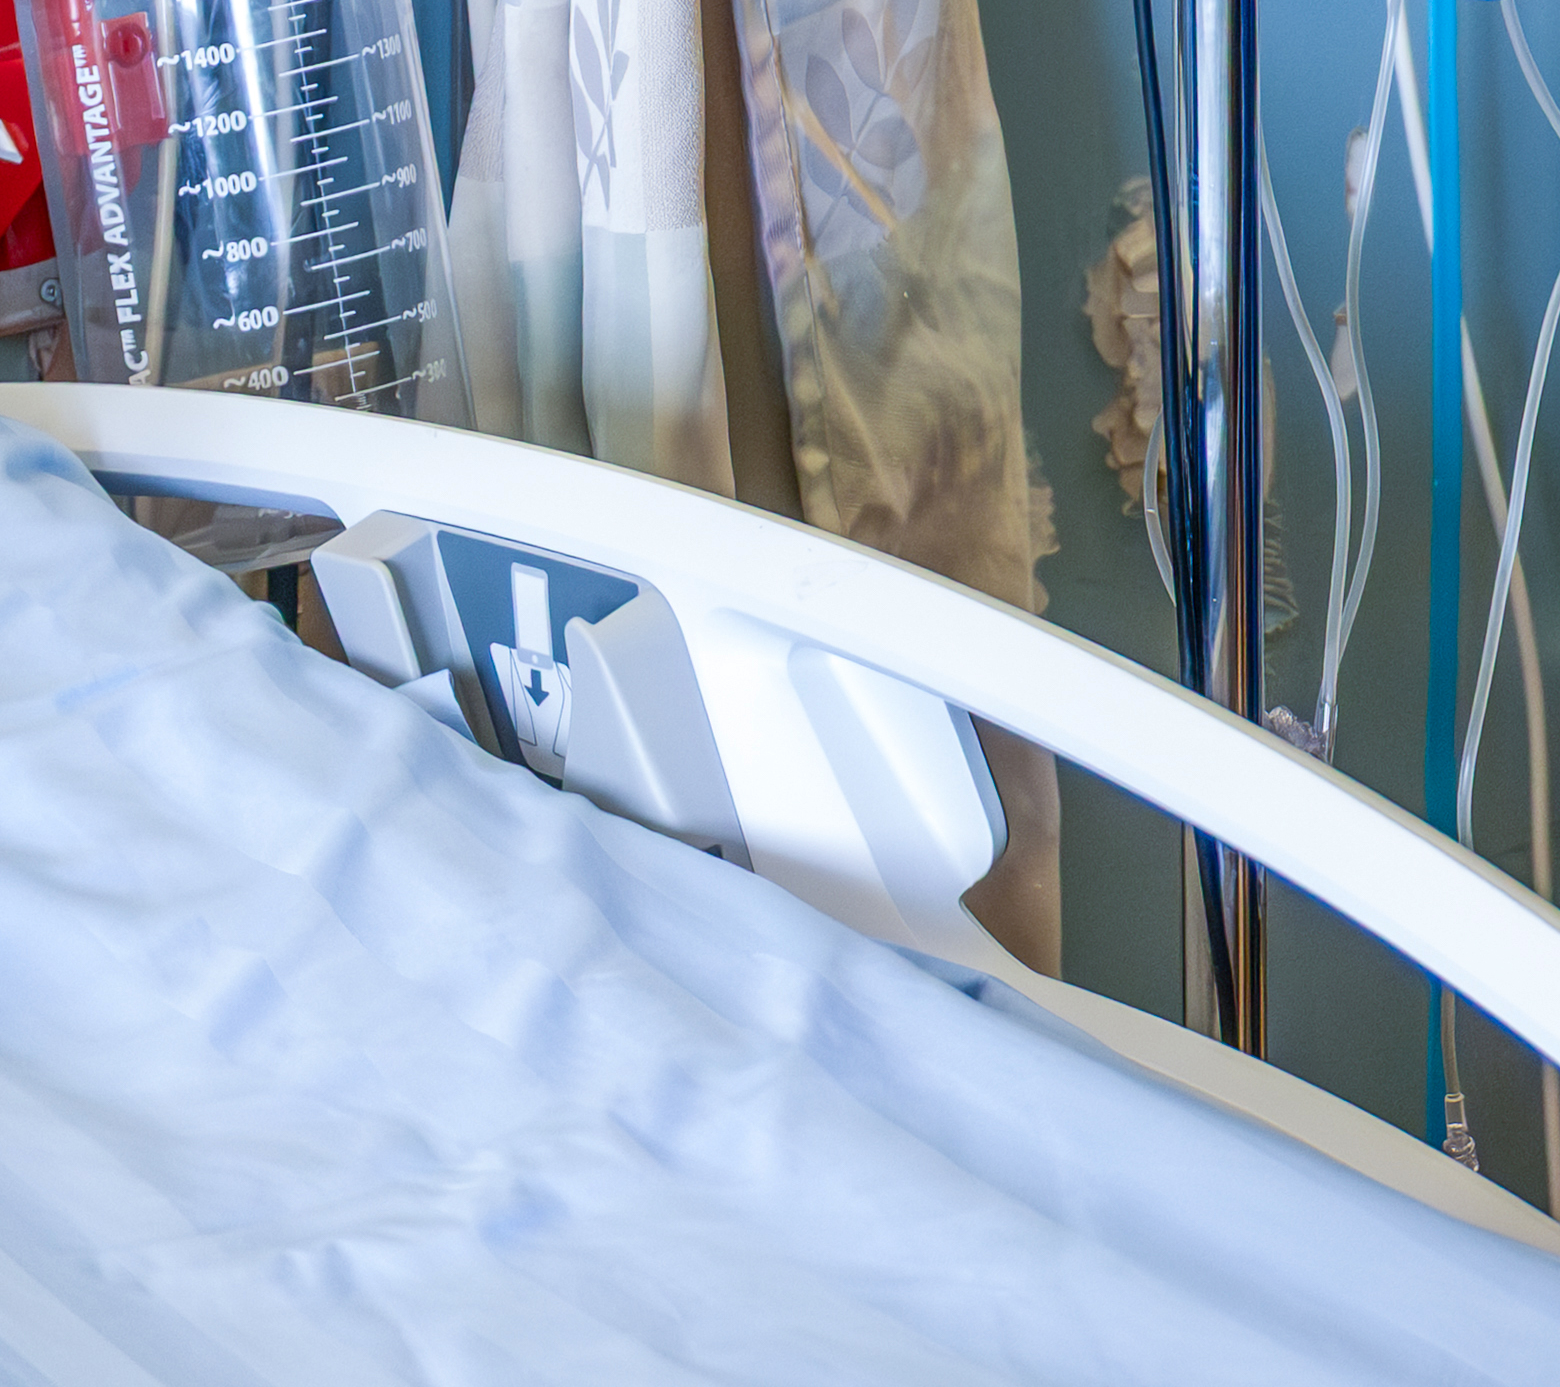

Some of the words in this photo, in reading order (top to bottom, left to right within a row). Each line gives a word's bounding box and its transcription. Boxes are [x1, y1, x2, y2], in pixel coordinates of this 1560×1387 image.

[156, 41, 236, 71] ~1400
[167, 109, 248, 138] ~1200
[178, 170, 258, 200] ~1000
[202, 236, 268, 263] ~800
[109, 251, 142, 325] FLEX
[212, 305, 280, 332] ~600
[223, 364, 290, 393] ~400
